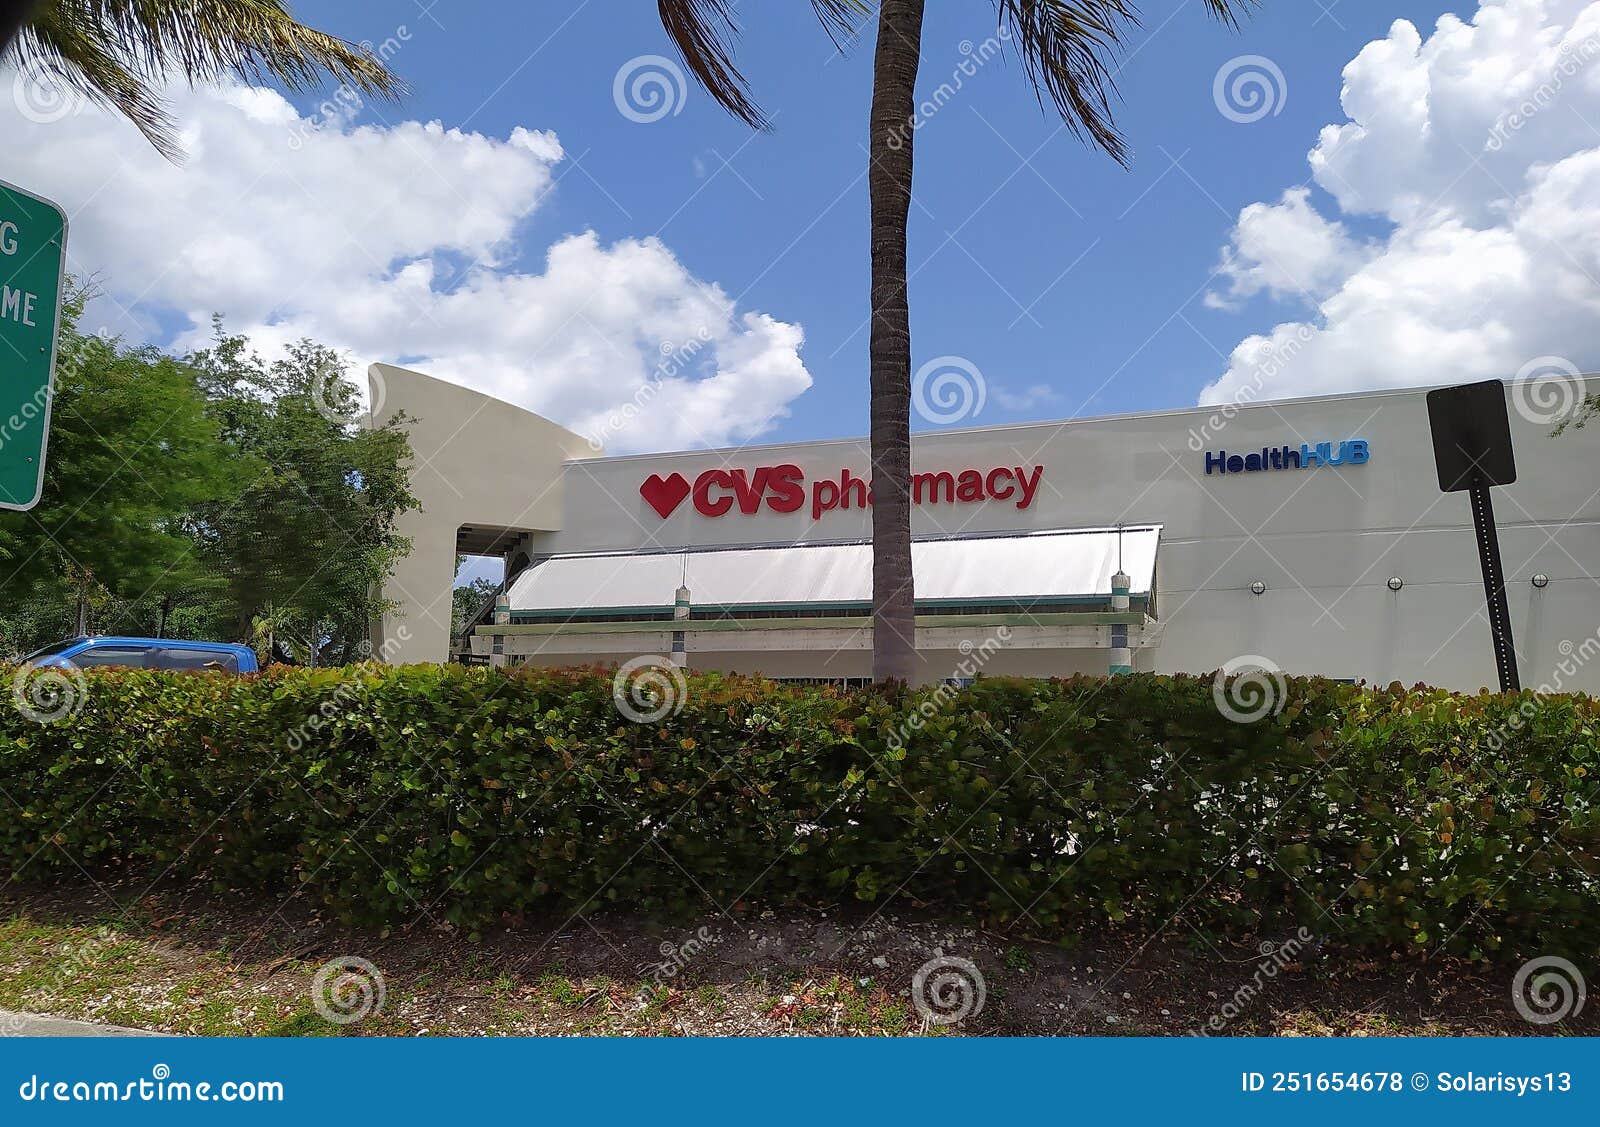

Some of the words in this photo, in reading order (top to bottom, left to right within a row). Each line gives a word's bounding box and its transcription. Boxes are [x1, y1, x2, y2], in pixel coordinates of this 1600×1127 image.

[1205, 438, 1370, 475] HealthHUB
[692, 464, 806, 518] CVS
[812, 465, 1044, 520] phmacy
